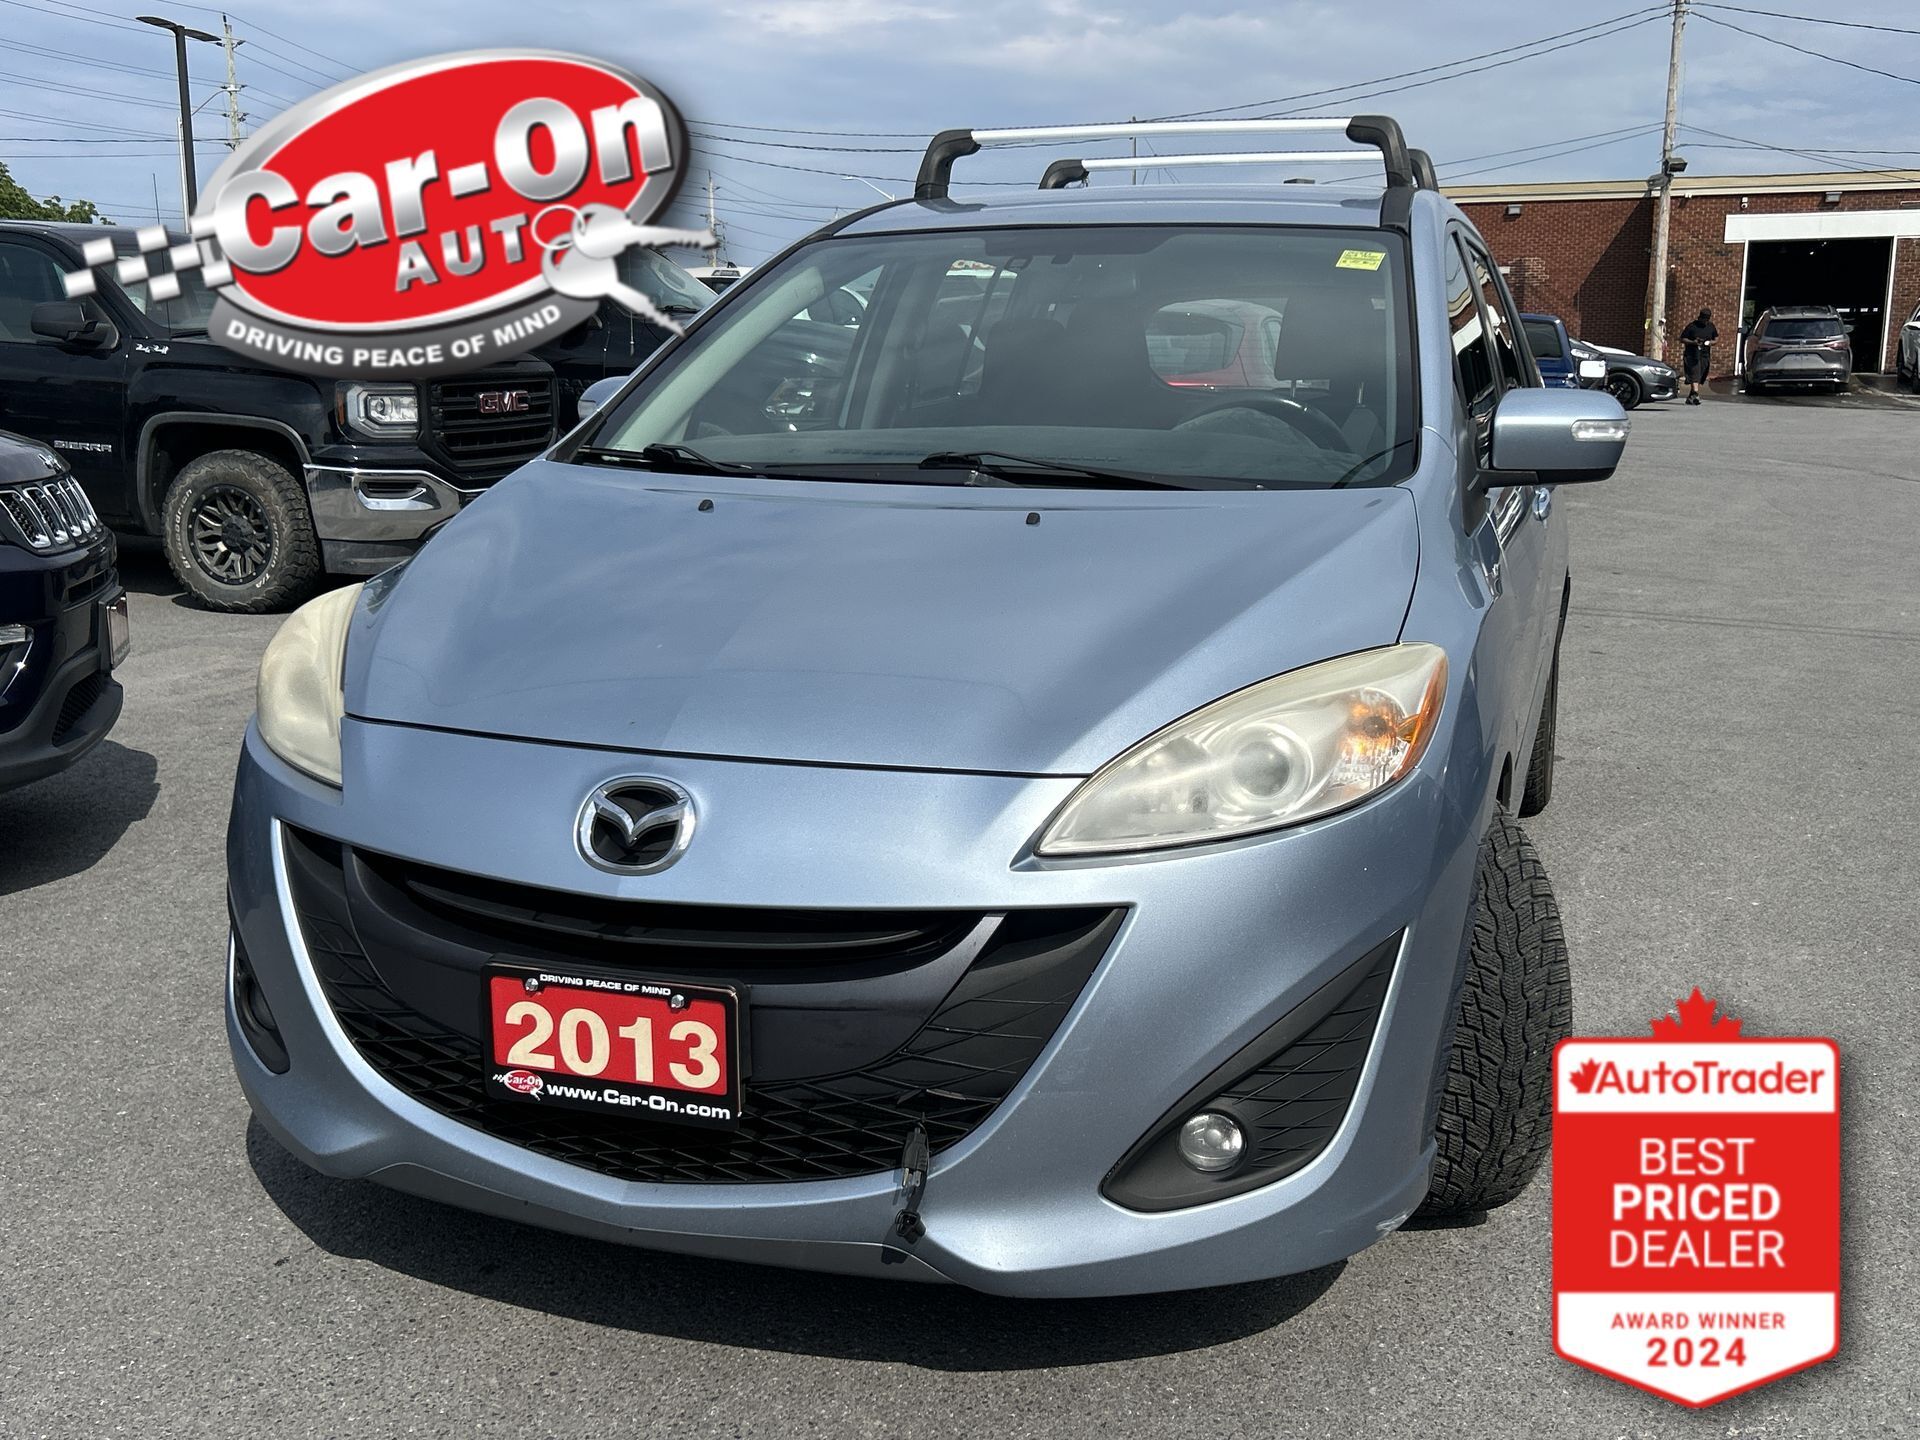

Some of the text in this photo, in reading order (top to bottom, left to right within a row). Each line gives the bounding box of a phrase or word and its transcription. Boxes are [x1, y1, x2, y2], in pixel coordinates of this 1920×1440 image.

[479, 390, 529, 413] GMC
[54, 440, 112, 452] SIERRA
[539, 974, 671, 996] DRIVING PEACE OF MIND
[505, 1001, 721, 1089] 2013
[506, 1074, 541, 1087] Car-On
[547, 1083, 731, 1120] www.Car-On.com
